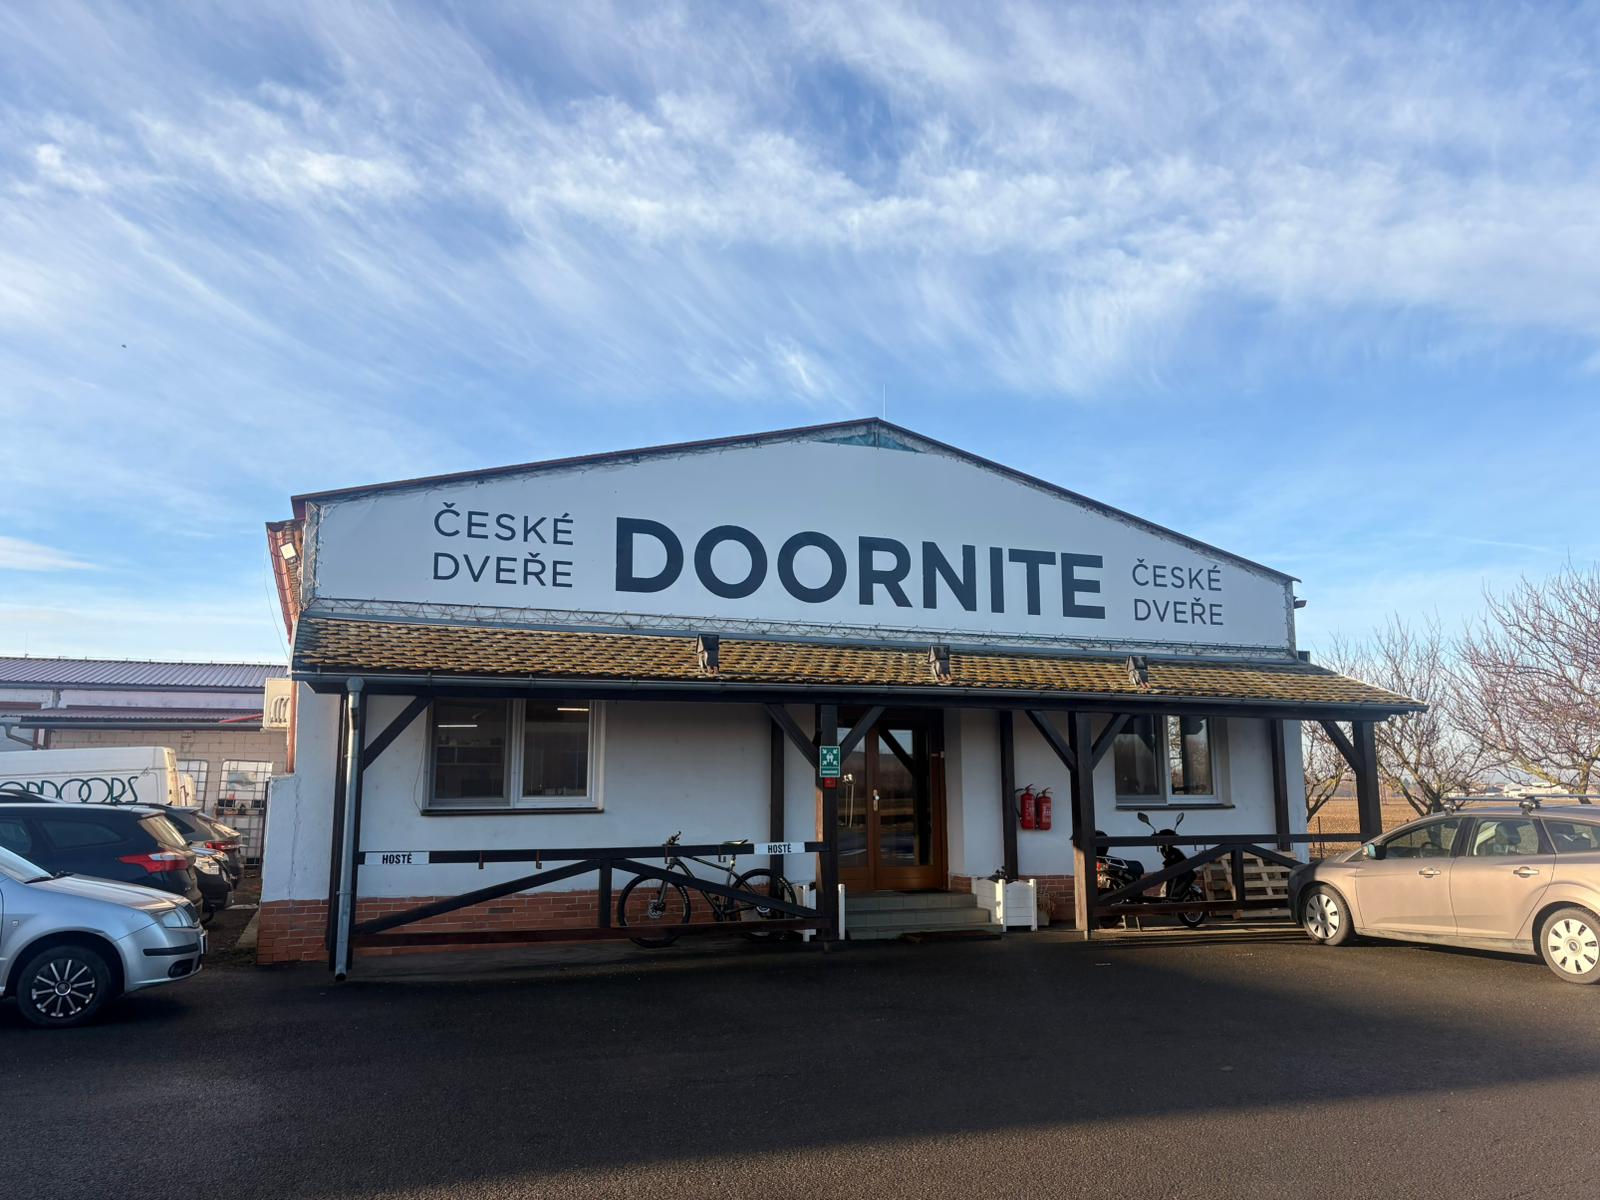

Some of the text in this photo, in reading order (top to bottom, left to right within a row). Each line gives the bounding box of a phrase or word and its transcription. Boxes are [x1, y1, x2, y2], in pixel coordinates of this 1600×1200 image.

[433, 501, 574, 546] ČESKÉ
[432, 551, 574, 588] DVEŘE
[615, 516, 1106, 620] DOORNITE
[1131, 558, 1222, 592] ČESKÉ
[1133, 597, 1224, 626] DVEŘE
